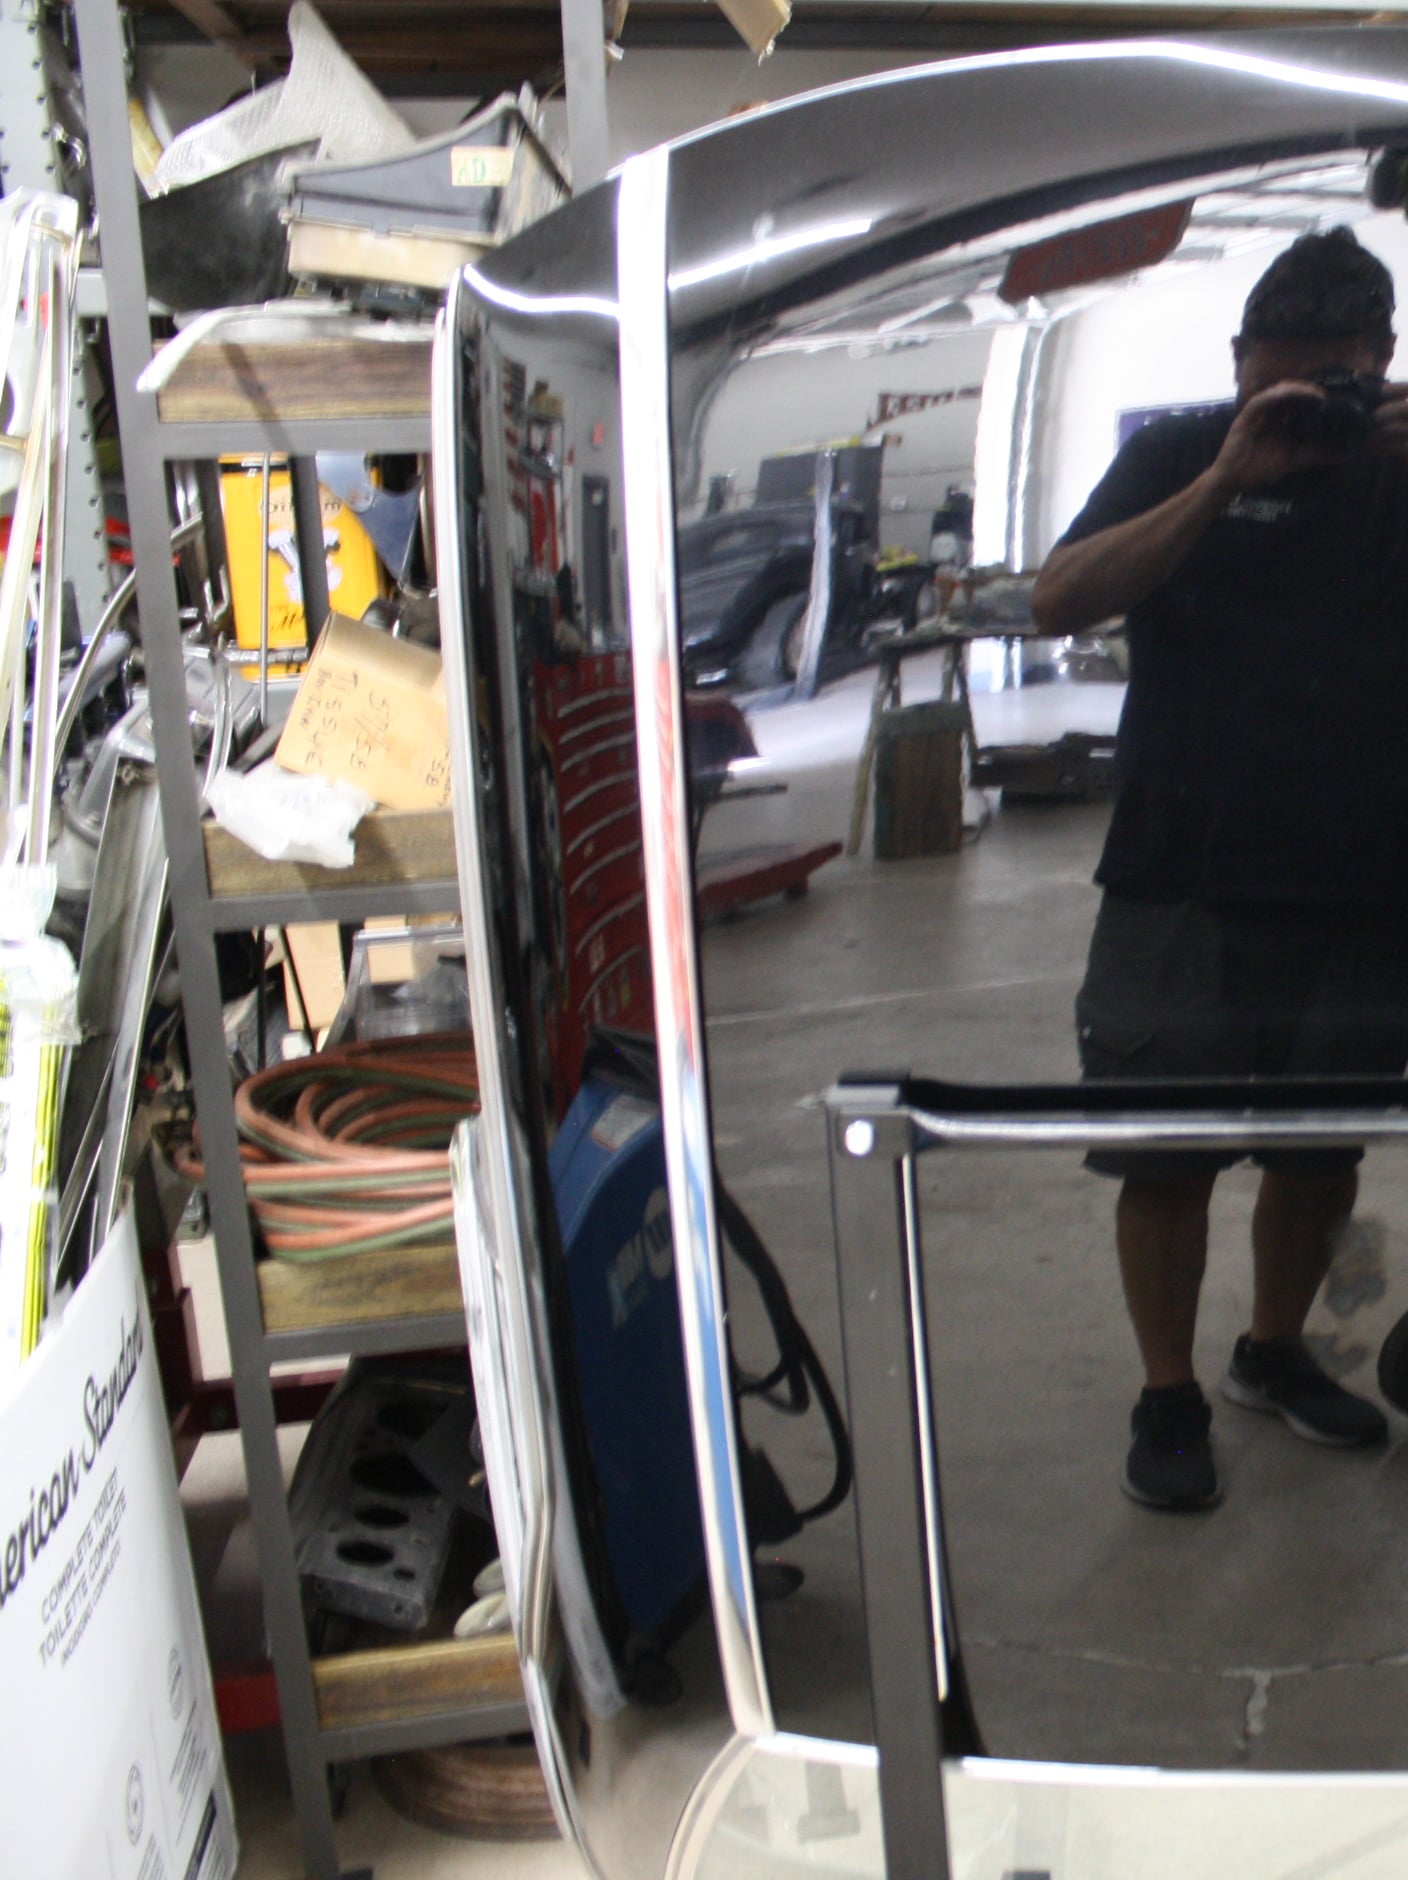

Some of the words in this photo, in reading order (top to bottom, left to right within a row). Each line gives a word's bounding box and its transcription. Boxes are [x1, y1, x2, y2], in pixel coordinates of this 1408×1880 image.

[0, 1446, 81, 1610] erican
[39, 1572, 89, 1668] TOILETTE
[88, 1487, 127, 1581] COMPLETE
[41, 1520, 94, 1625] COMPLETE
[94, 1466, 119, 1528] TOILET
